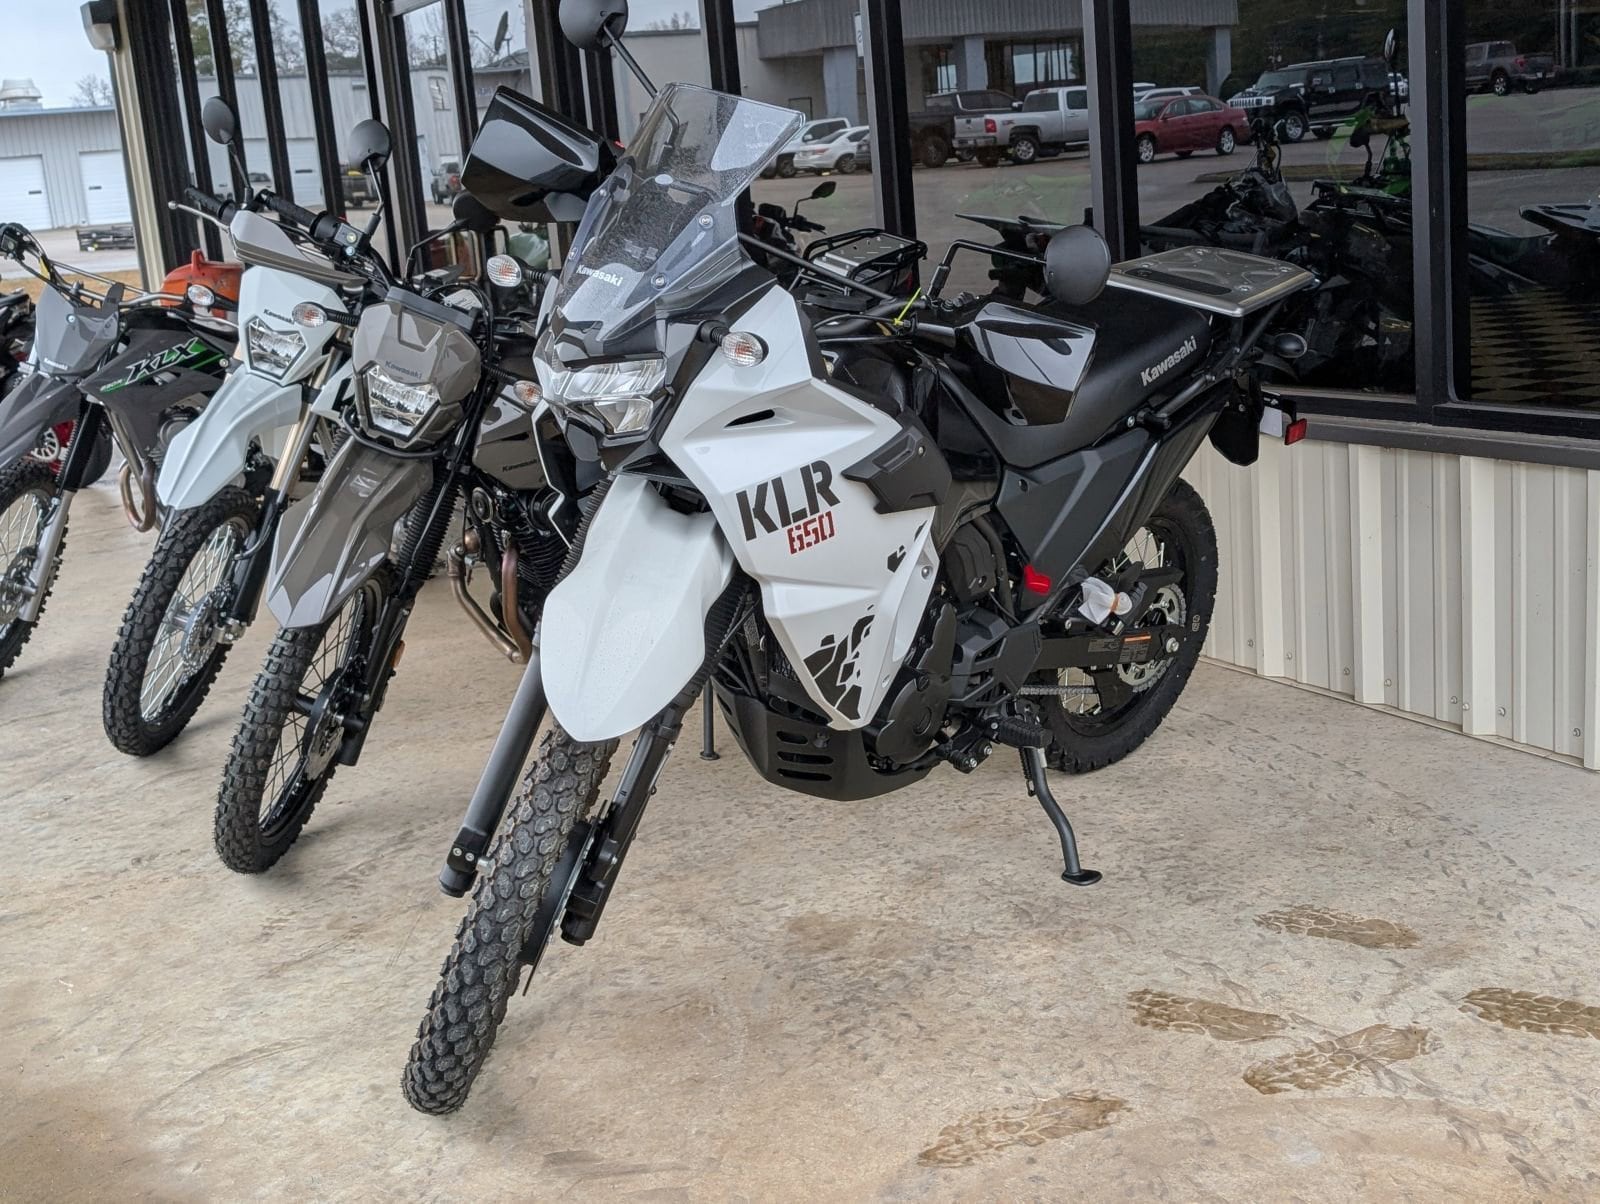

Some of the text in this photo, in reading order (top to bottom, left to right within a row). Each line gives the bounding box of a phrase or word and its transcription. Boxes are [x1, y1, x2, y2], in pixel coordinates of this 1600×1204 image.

[576, 264, 623, 287] Kawasaki
[125, 336, 199, 385] KLX
[1140, 335, 1197, 387] Kawasaki
[735, 459, 841, 542] KLR
[786, 510, 835, 555] 650
